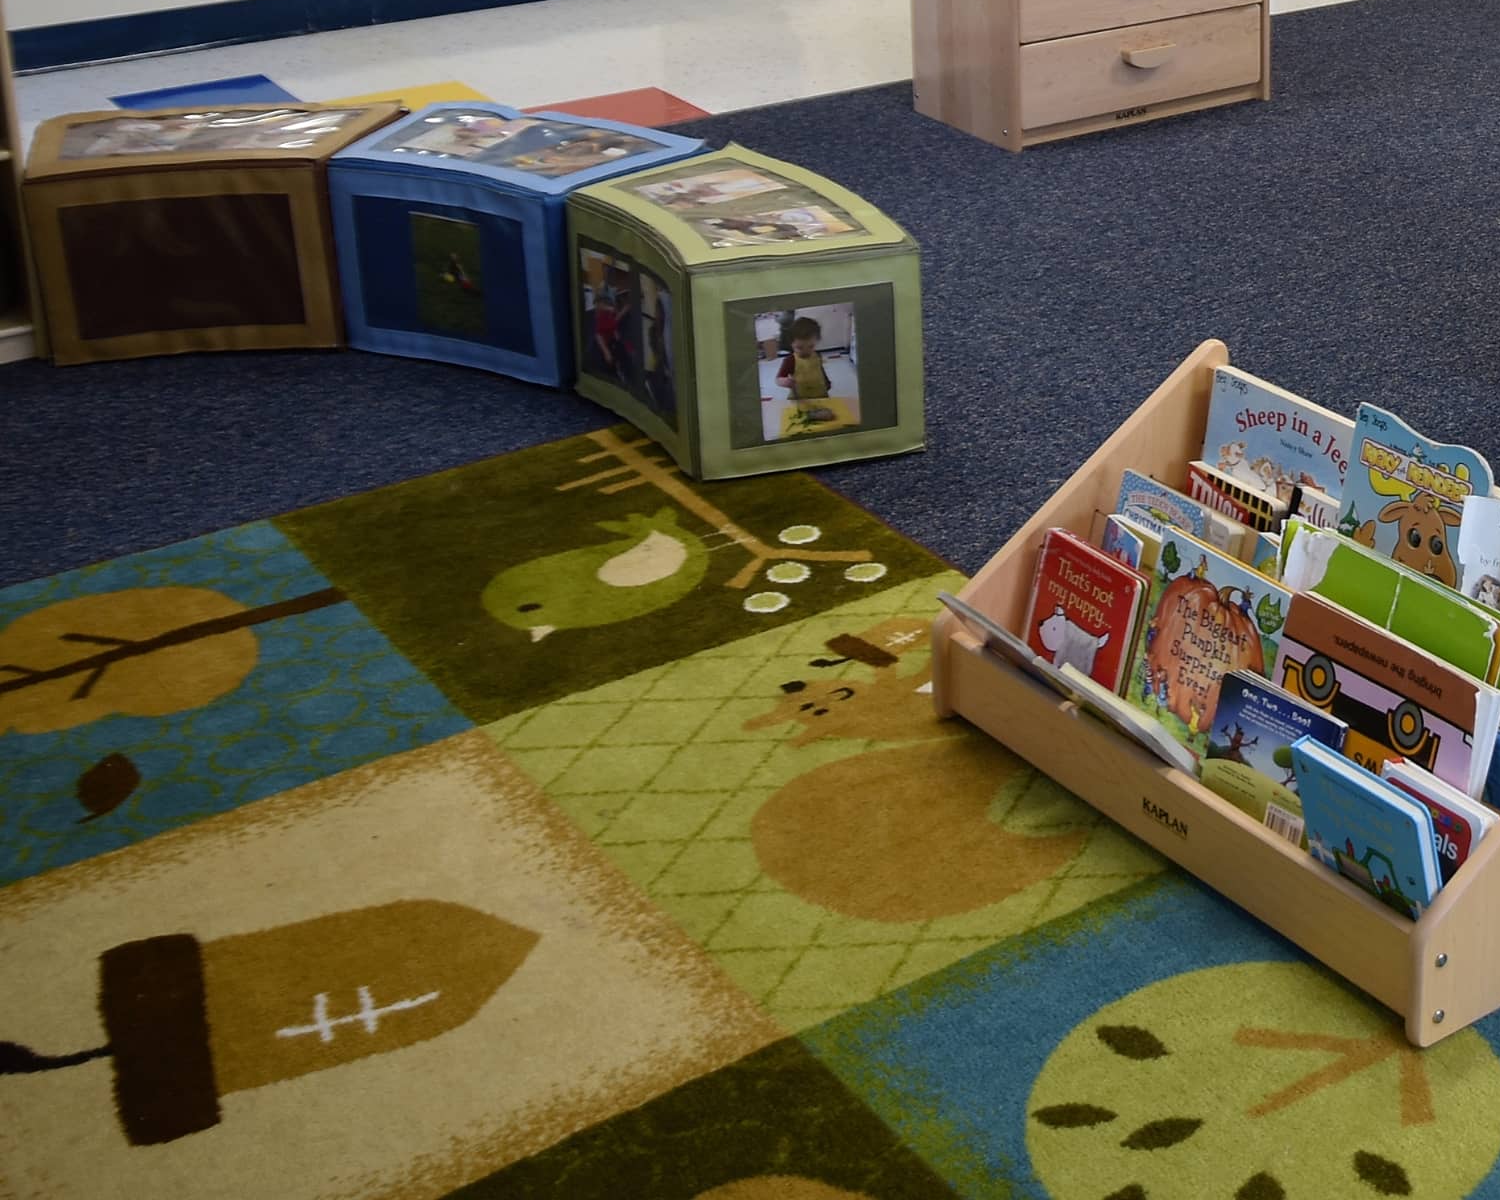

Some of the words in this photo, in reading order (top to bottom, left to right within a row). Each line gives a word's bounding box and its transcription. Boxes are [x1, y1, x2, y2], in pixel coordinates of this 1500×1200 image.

[1235, 408, 1287, 432] Sheep
[1292, 411, 1308, 437] in
[1312, 430, 1321, 446] a
[1323, 435, 1348, 487] Jee
[1057, 556, 1090, 593] That's
[1091, 584, 1115, 608] not
[1047, 579, 1067, 606] my
[1067, 591, 1113, 630] puppy...
[1176, 594, 1199, 620] The
[1199, 608, 1249, 652] Biggest
[1170, 639, 1225, 683] Surprise
[1183, 622, 1232, 666] Pumpkin
[1176, 665, 1210, 699] Ever!
[1389, 658, 1407, 679] the
[1407, 665, 1444, 702] bringing
[1354, 751, 1385, 776] WS
[1142, 796, 1188, 836] KAPLAN
[1434, 832, 1459, 861] als
